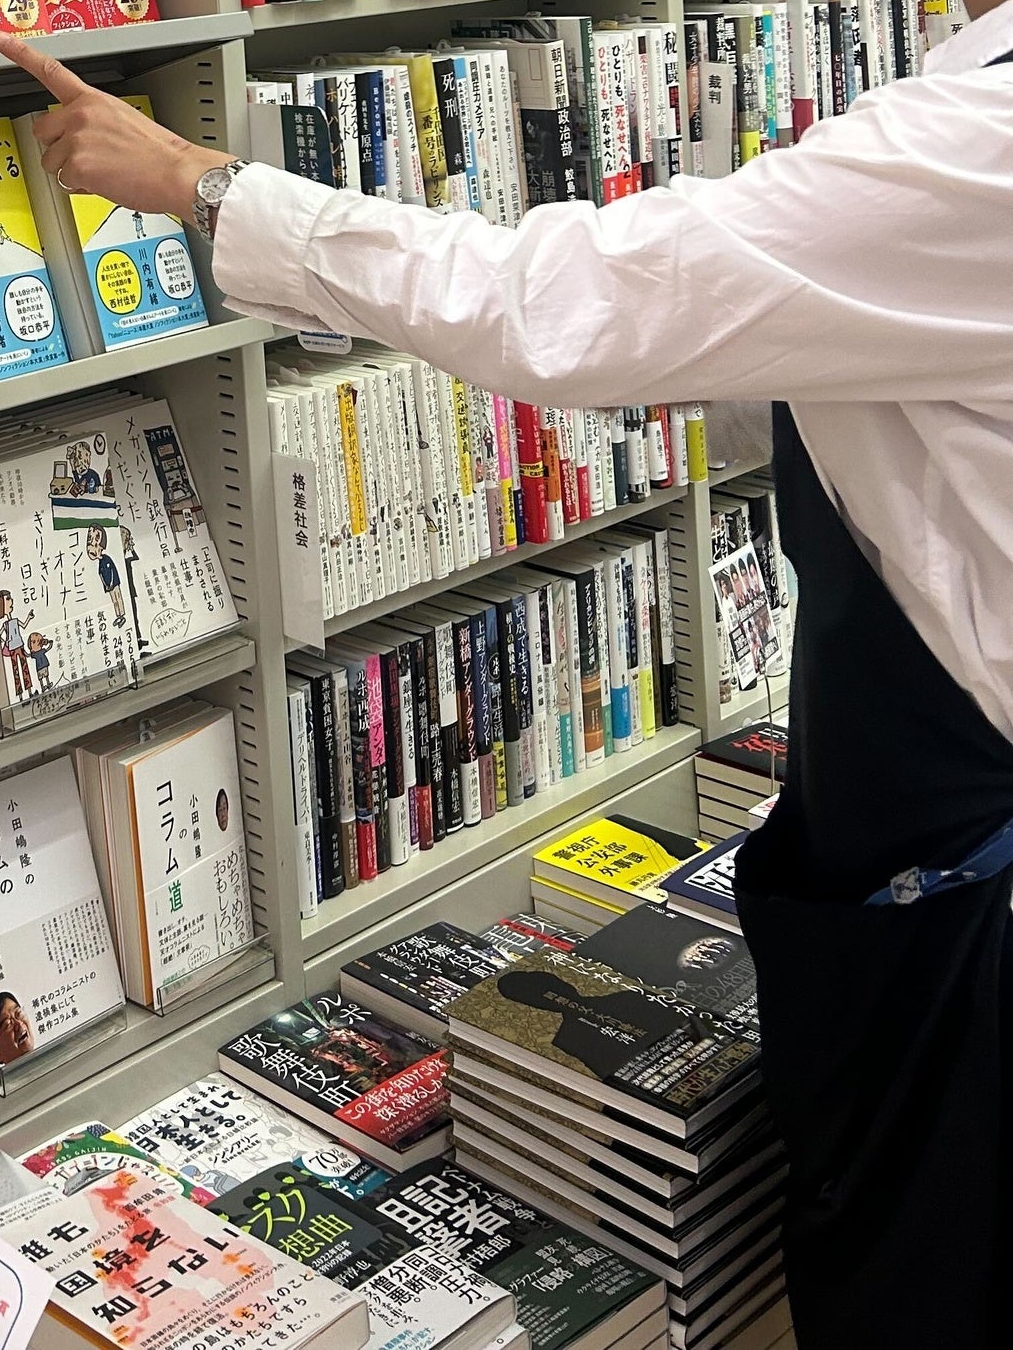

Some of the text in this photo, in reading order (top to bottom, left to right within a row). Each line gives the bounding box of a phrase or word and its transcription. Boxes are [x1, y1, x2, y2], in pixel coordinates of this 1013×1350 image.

[441, 73, 459, 118] 死刑
[550, 46, 573, 157] 朝日新聞政治部
[707, 74, 722, 105] 裁判
[305, 113, 320, 182] 在庫が無い本
[138, 248, 159, 306] 川内有緒
[19, 320, 51, 336] 坂口恭平
[112, 440, 143, 522] ぐだぐだ
[291, 472, 309, 549] 格差社会
[20, 564, 37, 604] 日記
[33, 510, 50, 607] ぎりぎり
[68, 533, 88, 603] コンビニ
[190, 555, 214, 613] まわされる
[6, 799, 35, 886] 小田嶋隆の
[189, 794, 202, 859] 小田嶋隆
[552, 835, 600, 862] 警視庁
[577, 842, 627, 869] 公安部
[599, 851, 648, 877] 外事課
[213, 860, 236, 951] おもしろい。
[316, 992, 373, 1027] ルポ
[226, 1030, 357, 1111] 歌舞伎町
[137, 1089, 243, 1153] 日本人として
[18, 1220, 89, 1263] 誰も
[55, 1227, 171, 1298] 国境を
[91, 1227, 241, 1325] 知らない
